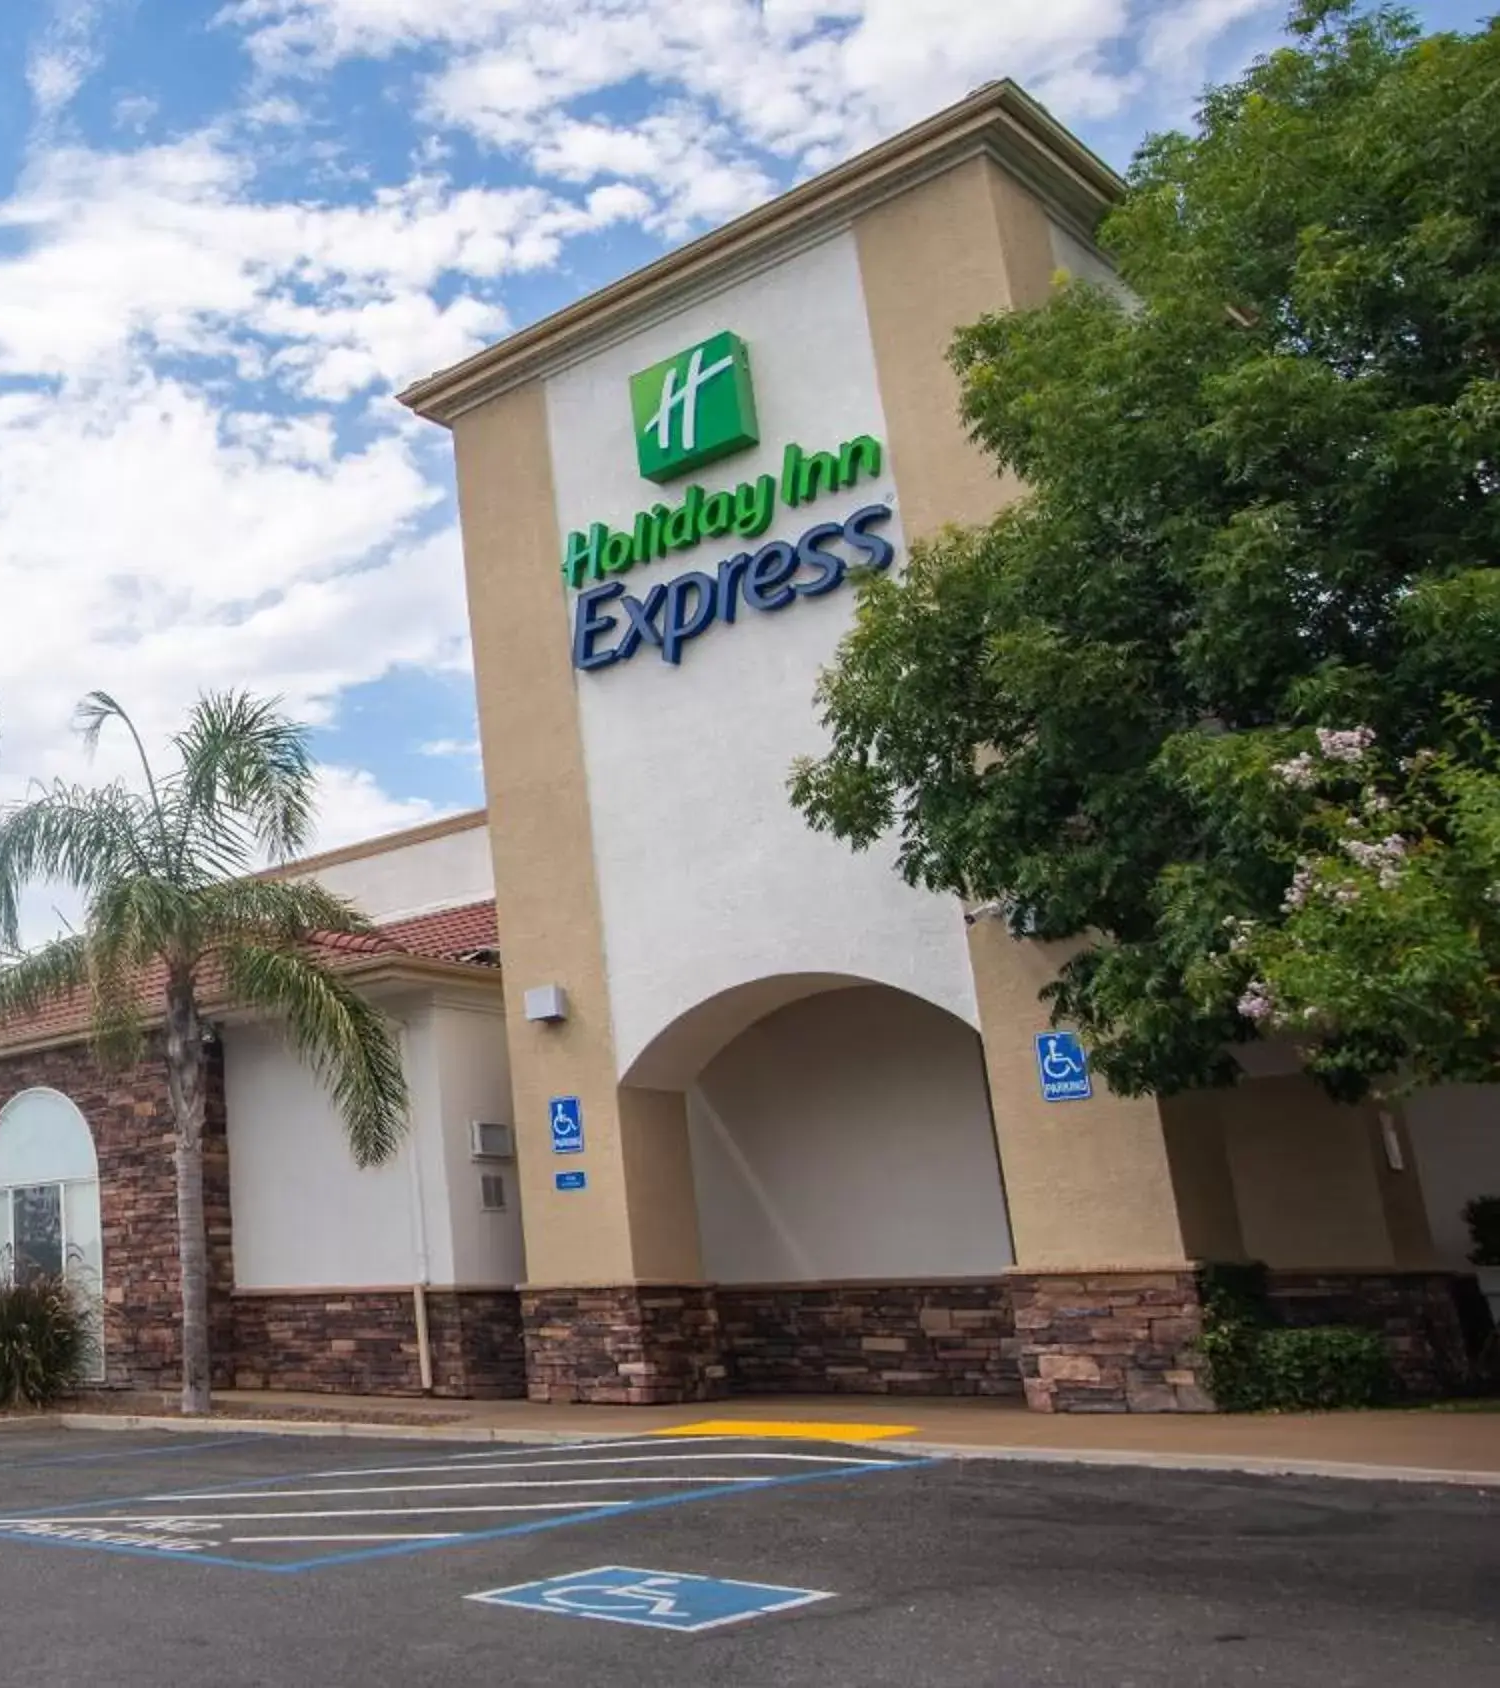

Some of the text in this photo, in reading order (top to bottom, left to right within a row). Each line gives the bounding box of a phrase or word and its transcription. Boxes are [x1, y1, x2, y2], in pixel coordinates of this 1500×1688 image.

[563, 434, 881, 588] Holiday Inn
[573, 503, 894, 671] Express
